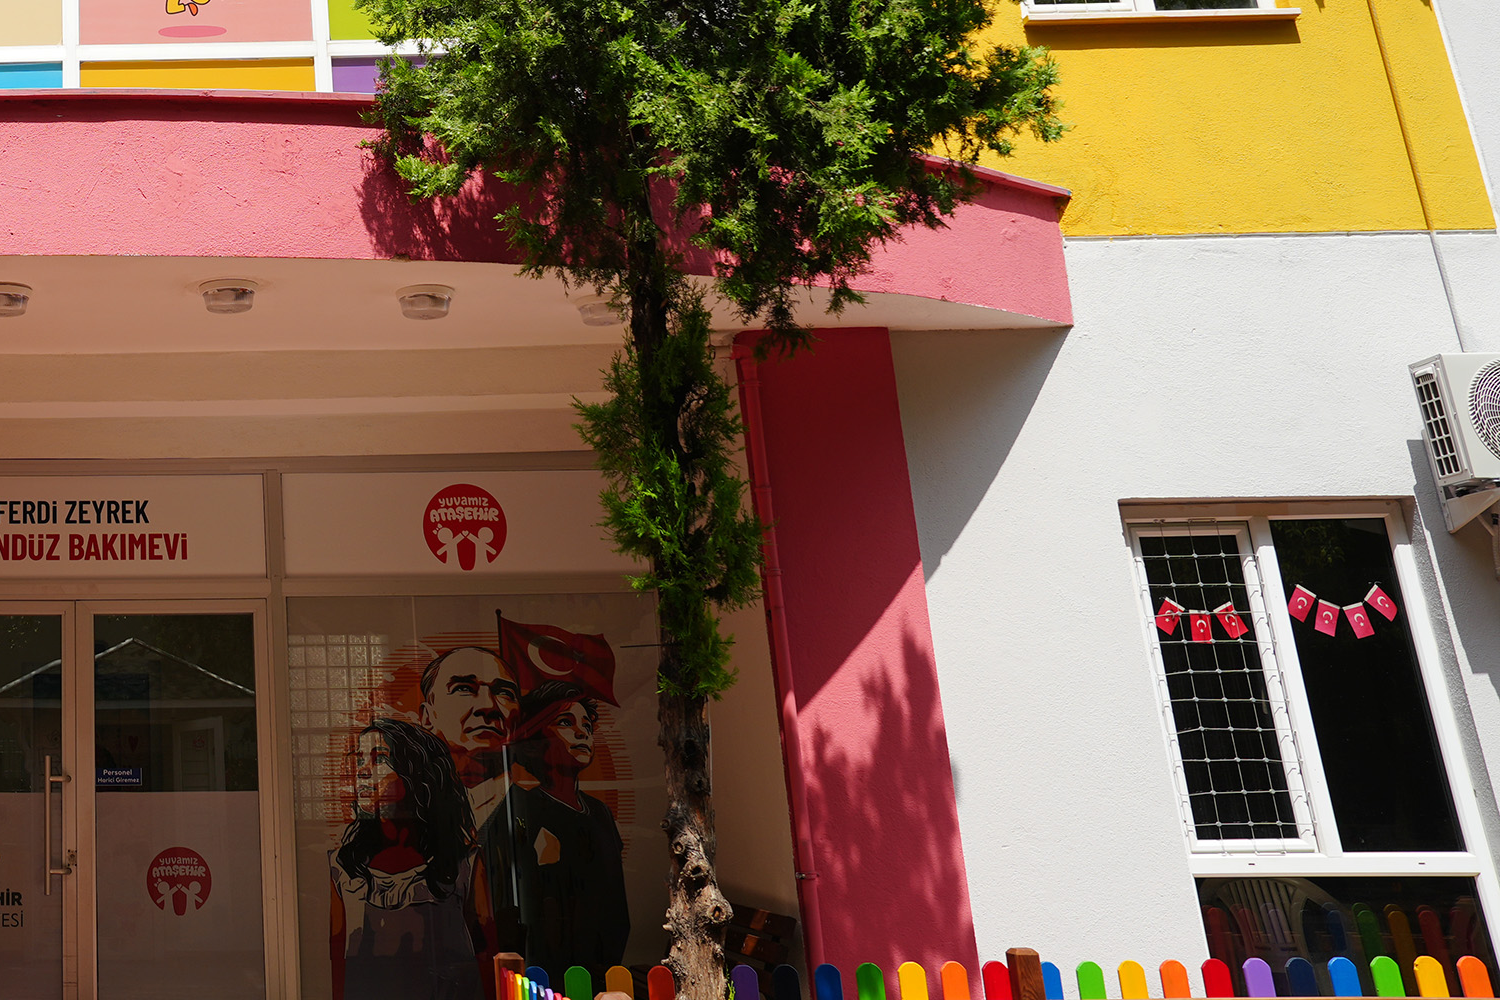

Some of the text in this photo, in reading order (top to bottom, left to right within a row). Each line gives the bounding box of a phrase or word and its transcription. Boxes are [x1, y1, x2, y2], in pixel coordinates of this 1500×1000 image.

[65, 500, 150, 524] ZEYREK
[430, 506, 499, 523] ATAŞEHİR
[69, 533, 188, 561] BAKIMEVİ
[152, 864, 206, 878] ATAŞEHİR
